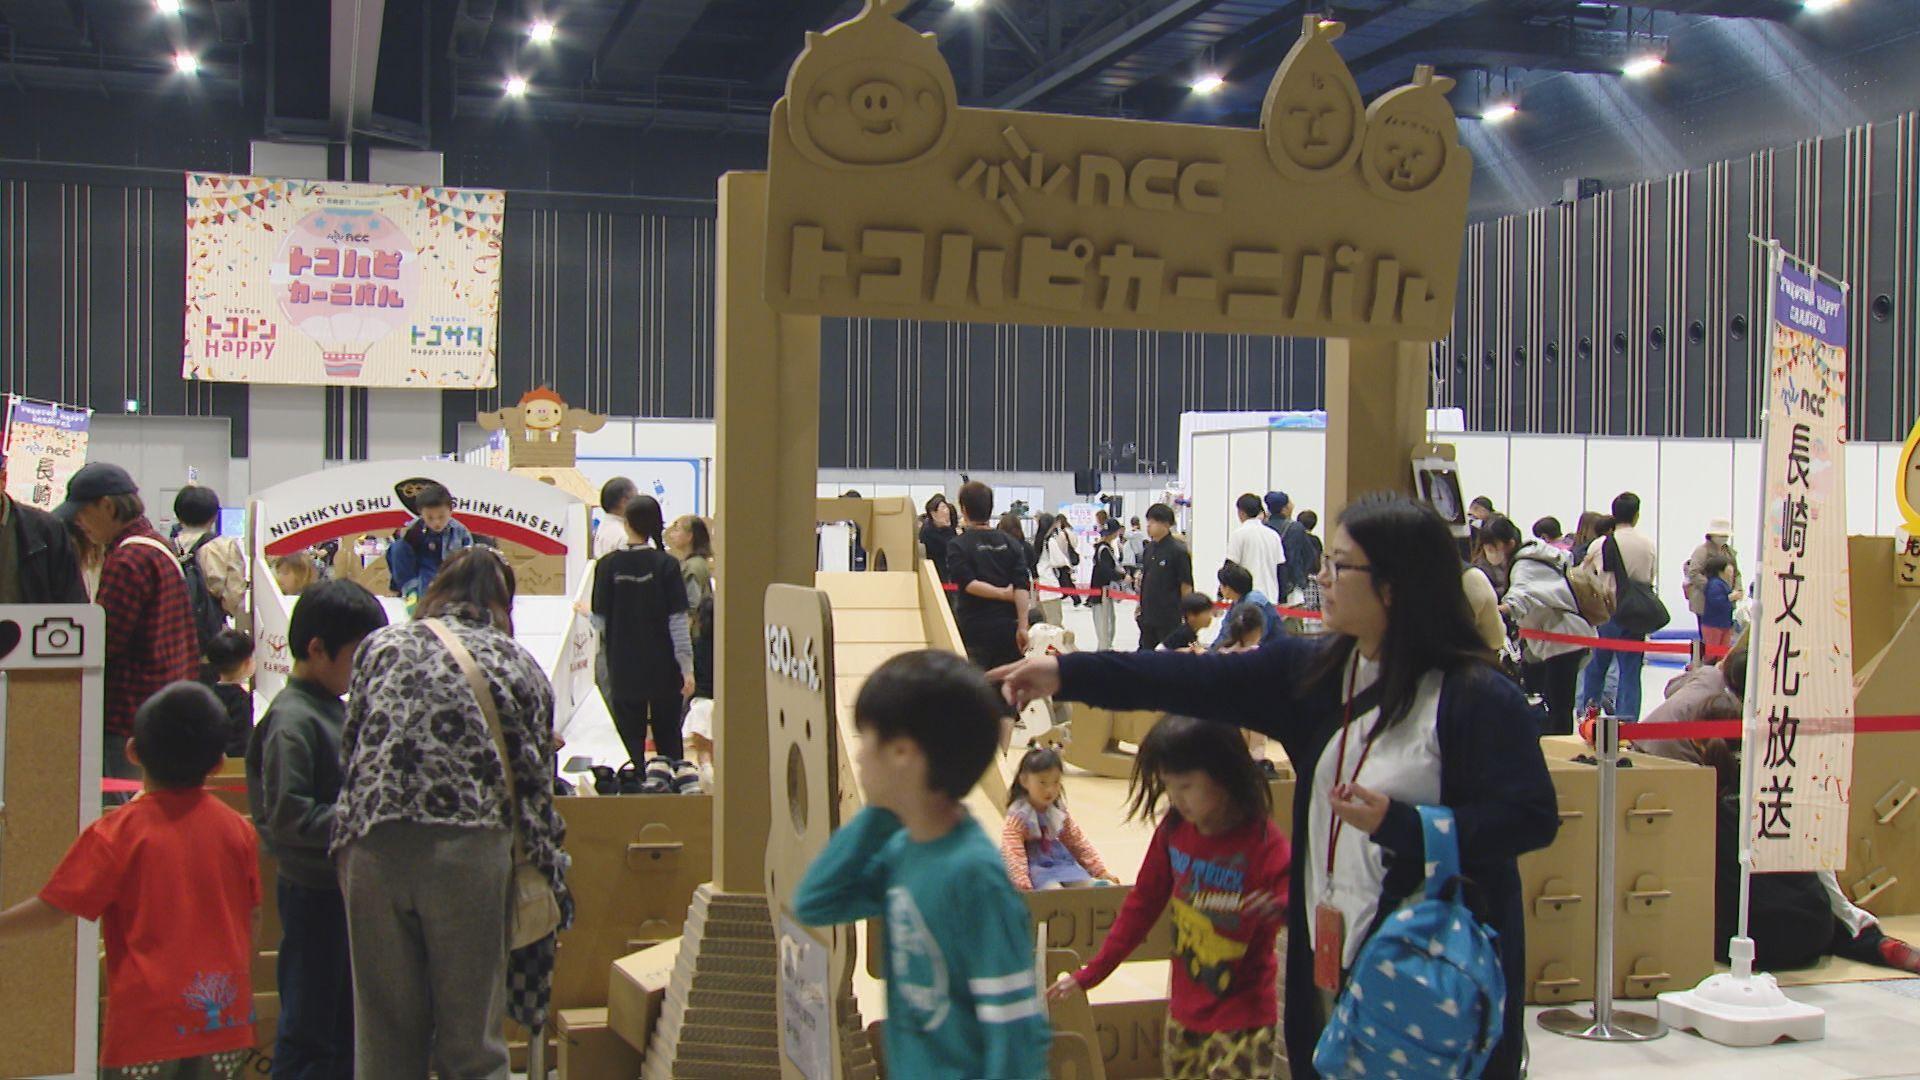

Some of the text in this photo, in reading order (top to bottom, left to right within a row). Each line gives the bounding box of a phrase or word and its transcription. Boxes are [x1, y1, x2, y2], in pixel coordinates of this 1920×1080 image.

[1077, 154, 1225, 213] ncc
[289, 246, 403, 280] トコハピ
[788, 224, 1438, 326] トコハピカーニバル
[288, 279, 404, 308] カーニバル
[206, 315, 277, 340] トコトン
[411, 325, 483, 347] トコサタ
[205, 339, 276, 360] Happy
[1800, 387, 1826, 418] ncc
[270, 495, 565, 538] NISHIKYUSHU SHINKANSEN
[1757, 422, 1811, 839] 長崎文化放送
